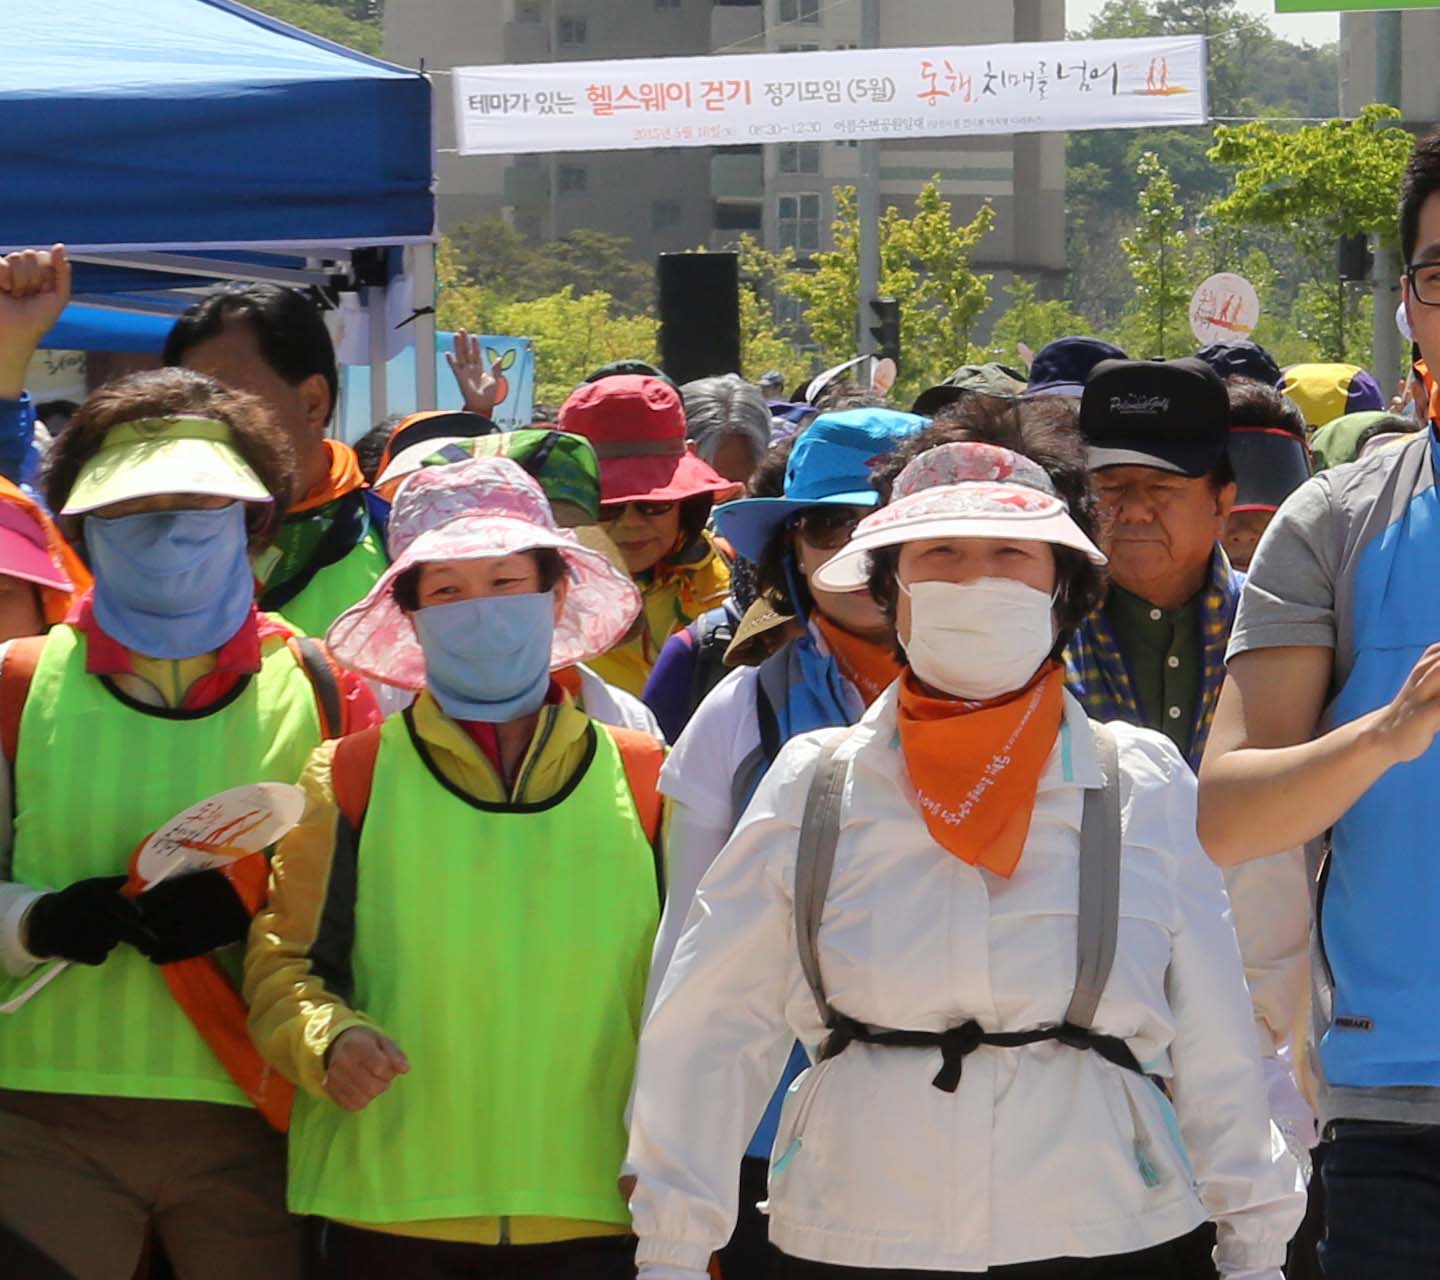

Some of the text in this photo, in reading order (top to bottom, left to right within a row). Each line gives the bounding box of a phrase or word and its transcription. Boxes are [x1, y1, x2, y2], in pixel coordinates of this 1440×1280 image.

[468, 91, 531, 115] 테마가
[534, 91, 576, 116] 있는
[585, 80, 693, 117] 헬스웨이
[699, 79, 753, 112] 걷기
[763, 78, 841, 106] 정기모임
[847, 75, 896, 103] (5월)
